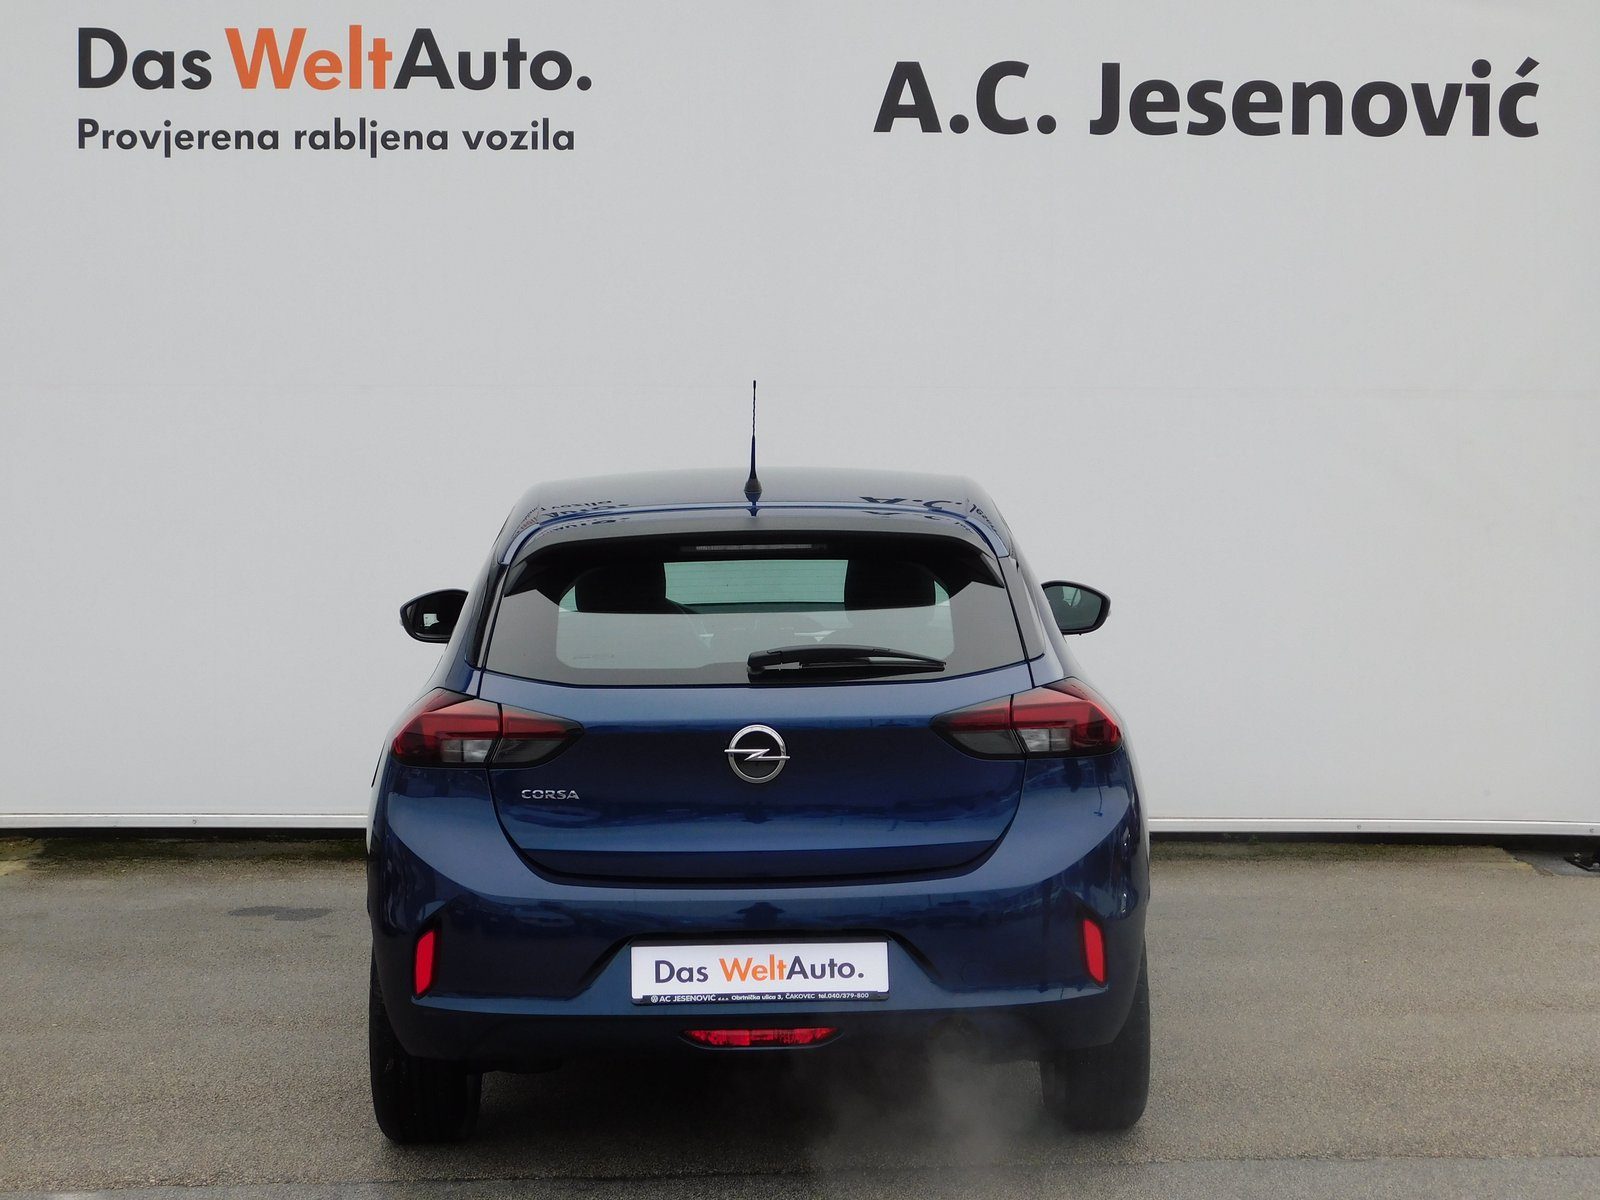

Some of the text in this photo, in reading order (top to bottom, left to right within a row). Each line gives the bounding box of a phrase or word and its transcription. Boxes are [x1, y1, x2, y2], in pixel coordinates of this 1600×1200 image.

[78, 25, 592, 92] Das WeltAuto.
[873, 57, 1540, 138] A.C. Jesenović
[78, 117, 575, 158] Provjerena rabljena vozila
[521, 788, 580, 800] CORSA
[655, 954, 865, 984] Das WeltAuto.
[659, 995, 671, 1003] AC
